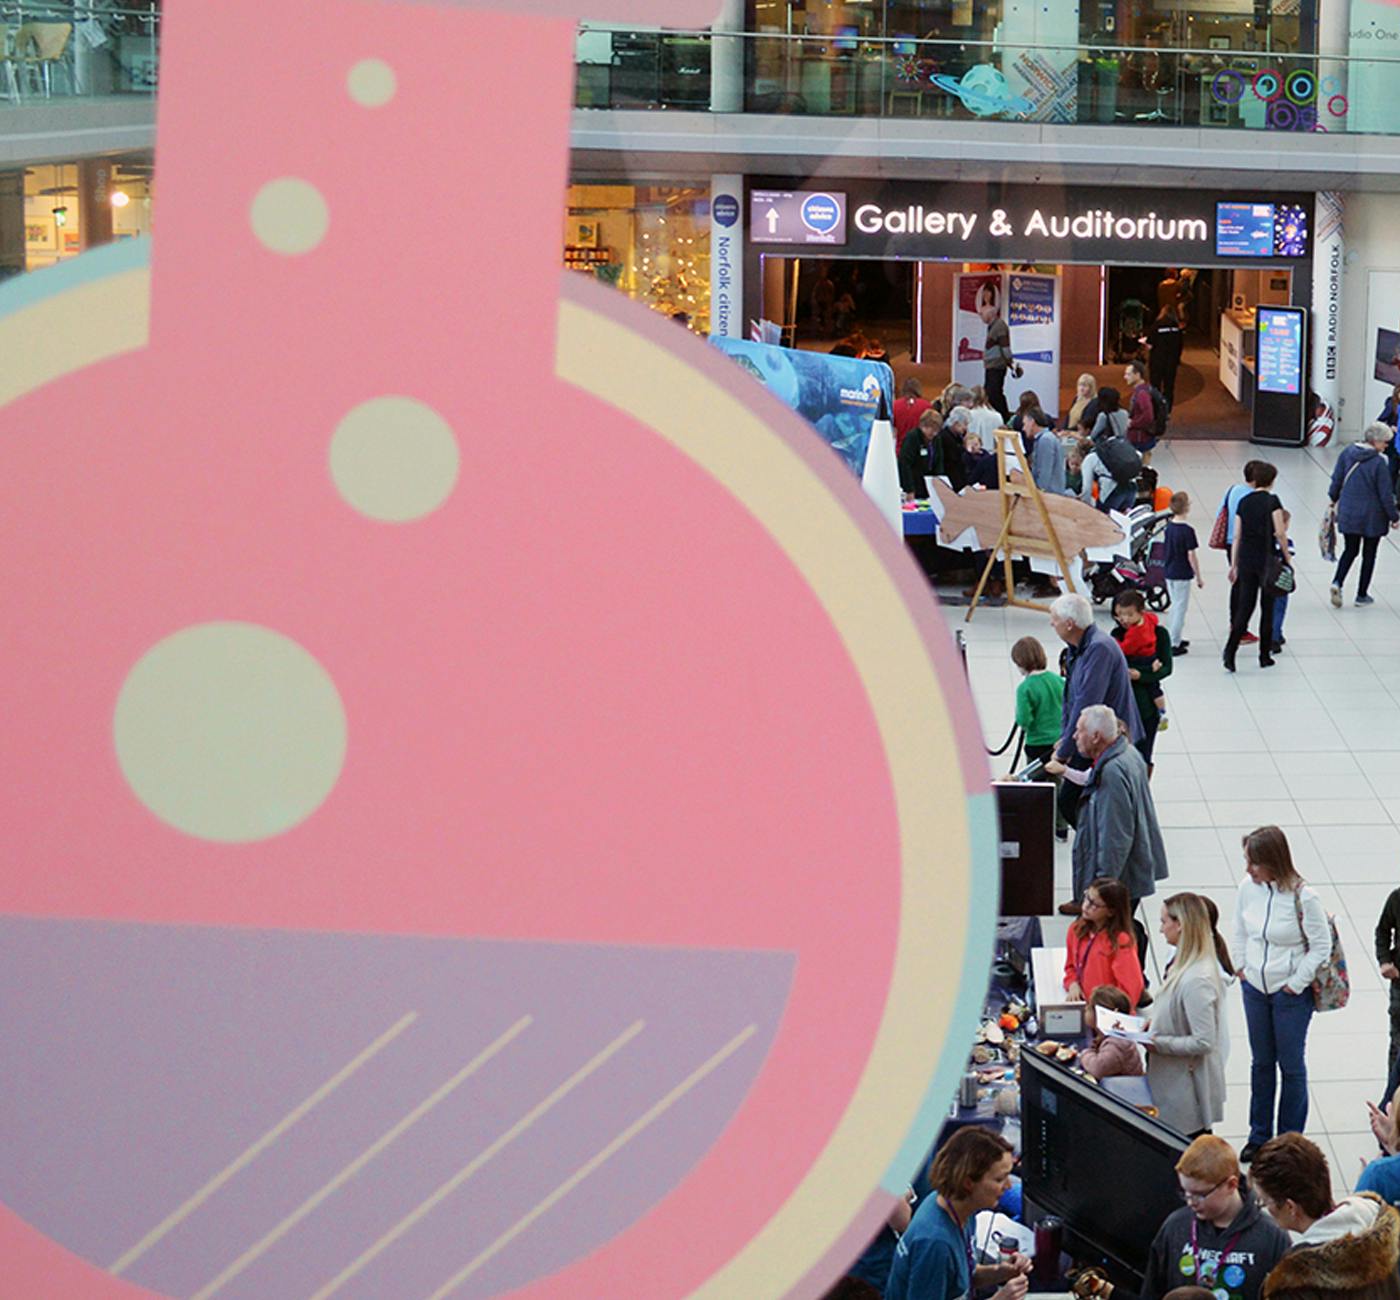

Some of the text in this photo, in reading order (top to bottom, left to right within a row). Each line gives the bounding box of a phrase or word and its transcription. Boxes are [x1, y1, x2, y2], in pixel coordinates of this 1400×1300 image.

[1348, 29, 1399, 40] udio One
[854, 204, 1208, 242] Gallery & Auditorium
[718, 237, 732, 290] Norfolk
[1326, 244, 1341, 380] BBC RADIO NORFOLK
[840, 388, 869, 402] marine
[1182, 1242, 1255, 1265] MNECAFT
